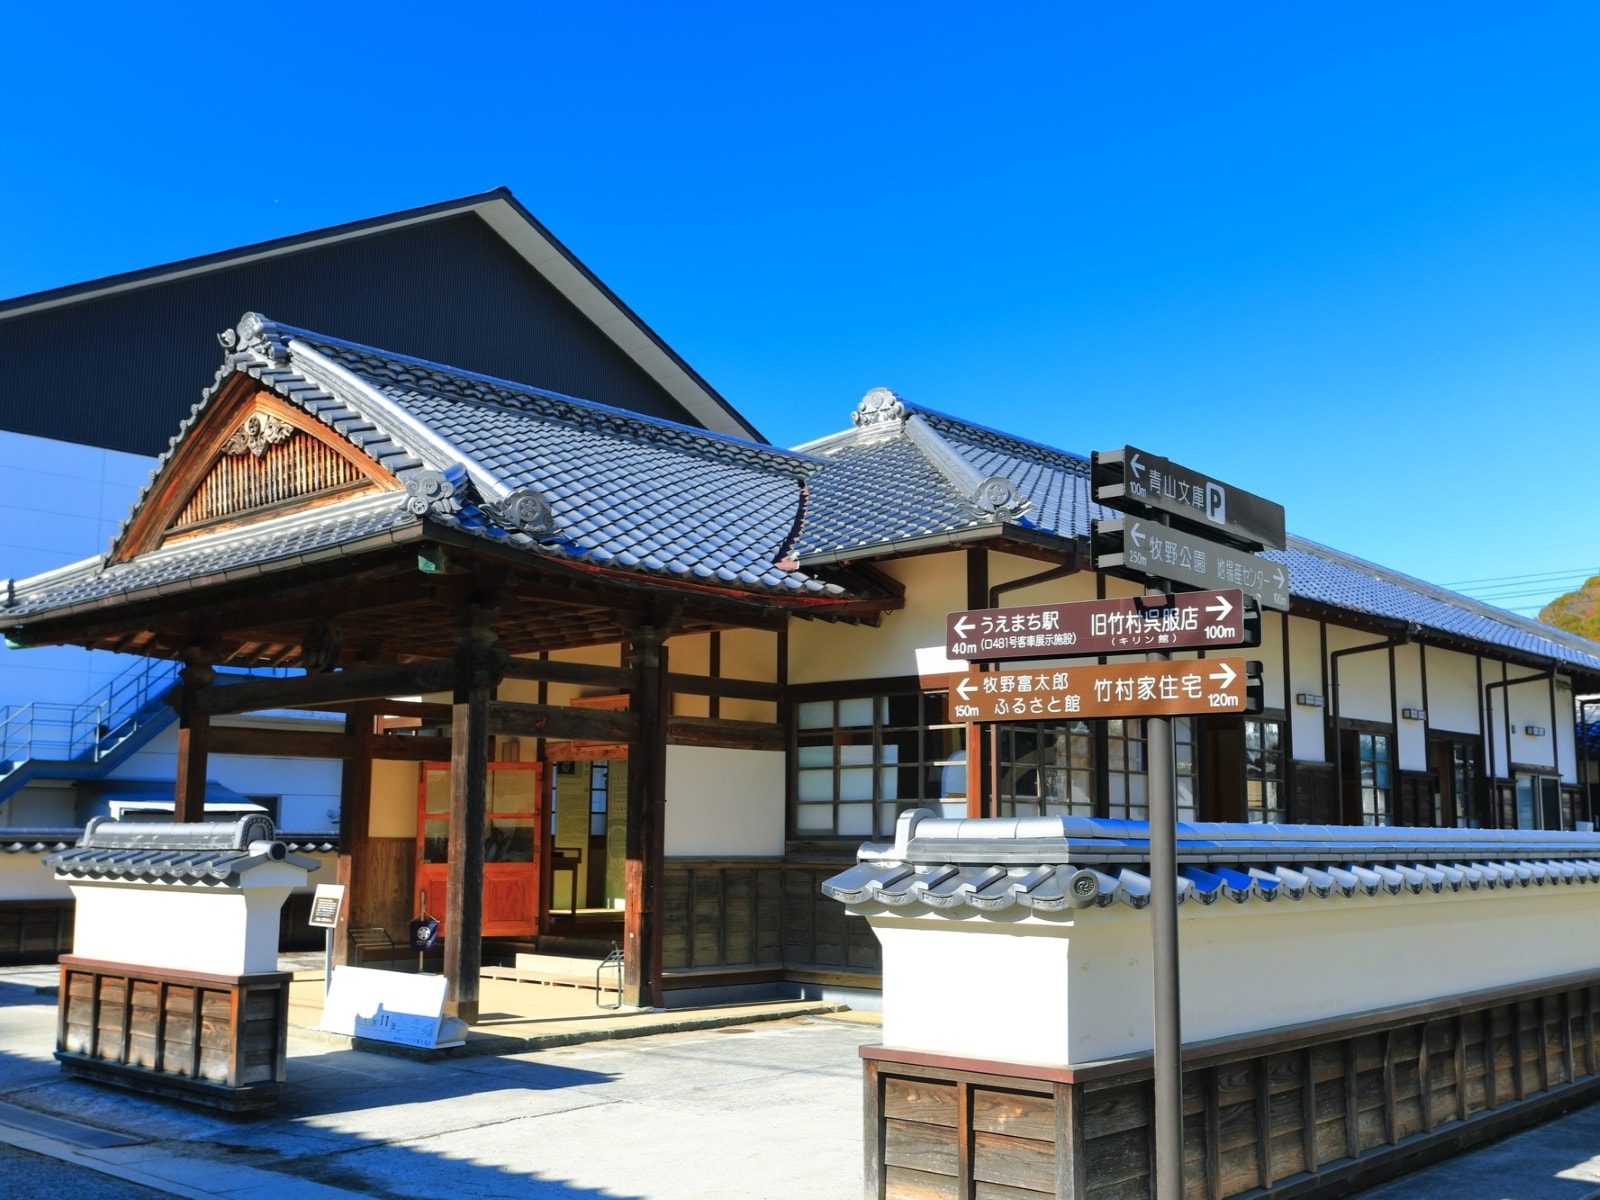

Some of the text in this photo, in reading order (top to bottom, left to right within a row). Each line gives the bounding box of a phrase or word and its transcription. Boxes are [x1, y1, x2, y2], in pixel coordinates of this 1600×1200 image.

[1129, 481, 1147, 498] 100m
[1148, 469, 1222, 517] 青山文庫 P
[1129, 549, 1148, 567] 250m
[1149, 536, 1206, 574] 牧野公園
[1216, 557, 1270, 590] 地場産センター
[980, 611, 1060, 635] うえまち駅
[1091, 606, 1199, 637] 旧竹村呉服店
[1204, 625, 1236, 640] 100m
[951, 642, 977, 655] 40m
[983, 672, 1069, 694] 牧野富太郎
[1093, 673, 1203, 703] 竹村家住宅
[954, 705, 979, 717] 150m
[994, 694, 1081, 715] ふるさと館
[1208, 693, 1239, 708] 120m
